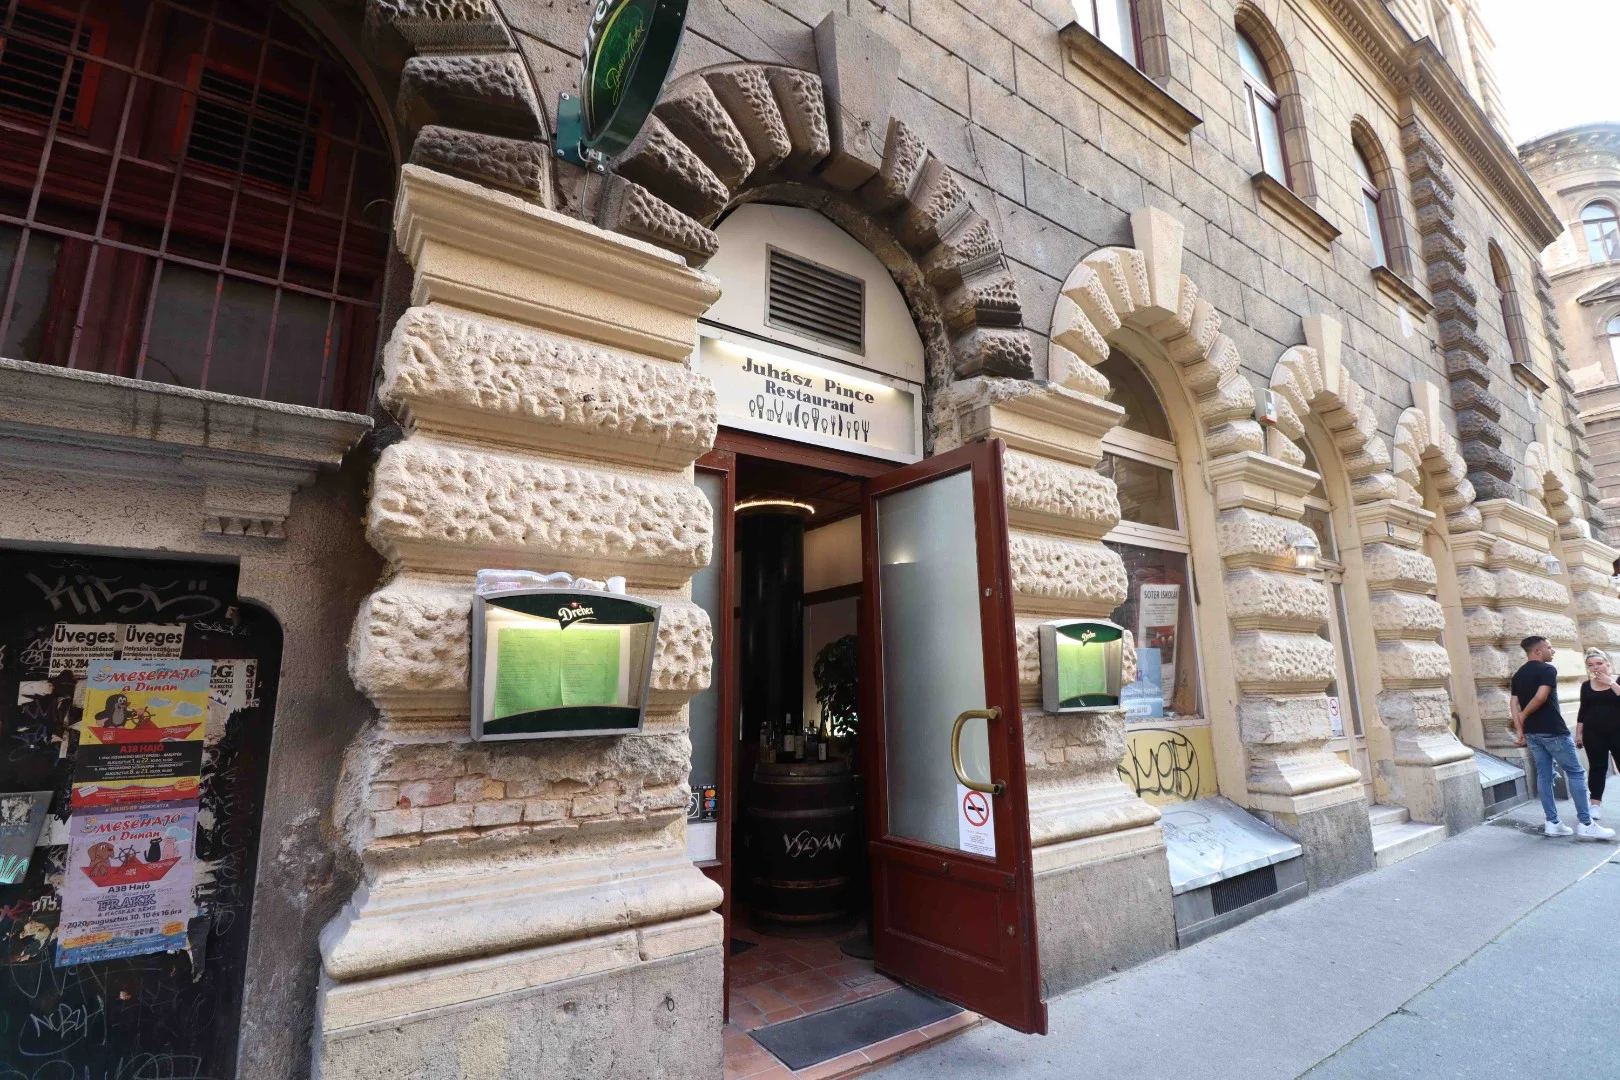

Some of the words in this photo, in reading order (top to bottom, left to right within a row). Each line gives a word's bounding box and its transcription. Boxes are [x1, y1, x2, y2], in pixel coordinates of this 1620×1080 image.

[742, 357, 813, 388] Juhász
[824, 378, 875, 404] Pince
[765, 380, 855, 415] Restaurant
[1144, 590, 1160, 600] SOTER
[558, 605, 594, 621] Dreher
[55, 625, 116, 646] Üveges
[126, 625, 183, 646] Üveges
[108, 666, 200, 684] MESEHAJÓ
[135, 682, 178, 692] Dunán
[120, 745, 139, 753] A38
[139, 743, 166, 753] HAJÓ
[95, 811, 182, 834] MESEHAJÓ
[120, 830, 160, 841] Dunán
[108, 885, 127, 894] A38
[129, 882, 151, 893] Hajó
[97, 893, 157, 912] FRAKK
[90, 915, 129, 928] augusztus
[129, 913, 141, 921] 30.
[170, 909, 182, 917] óra
